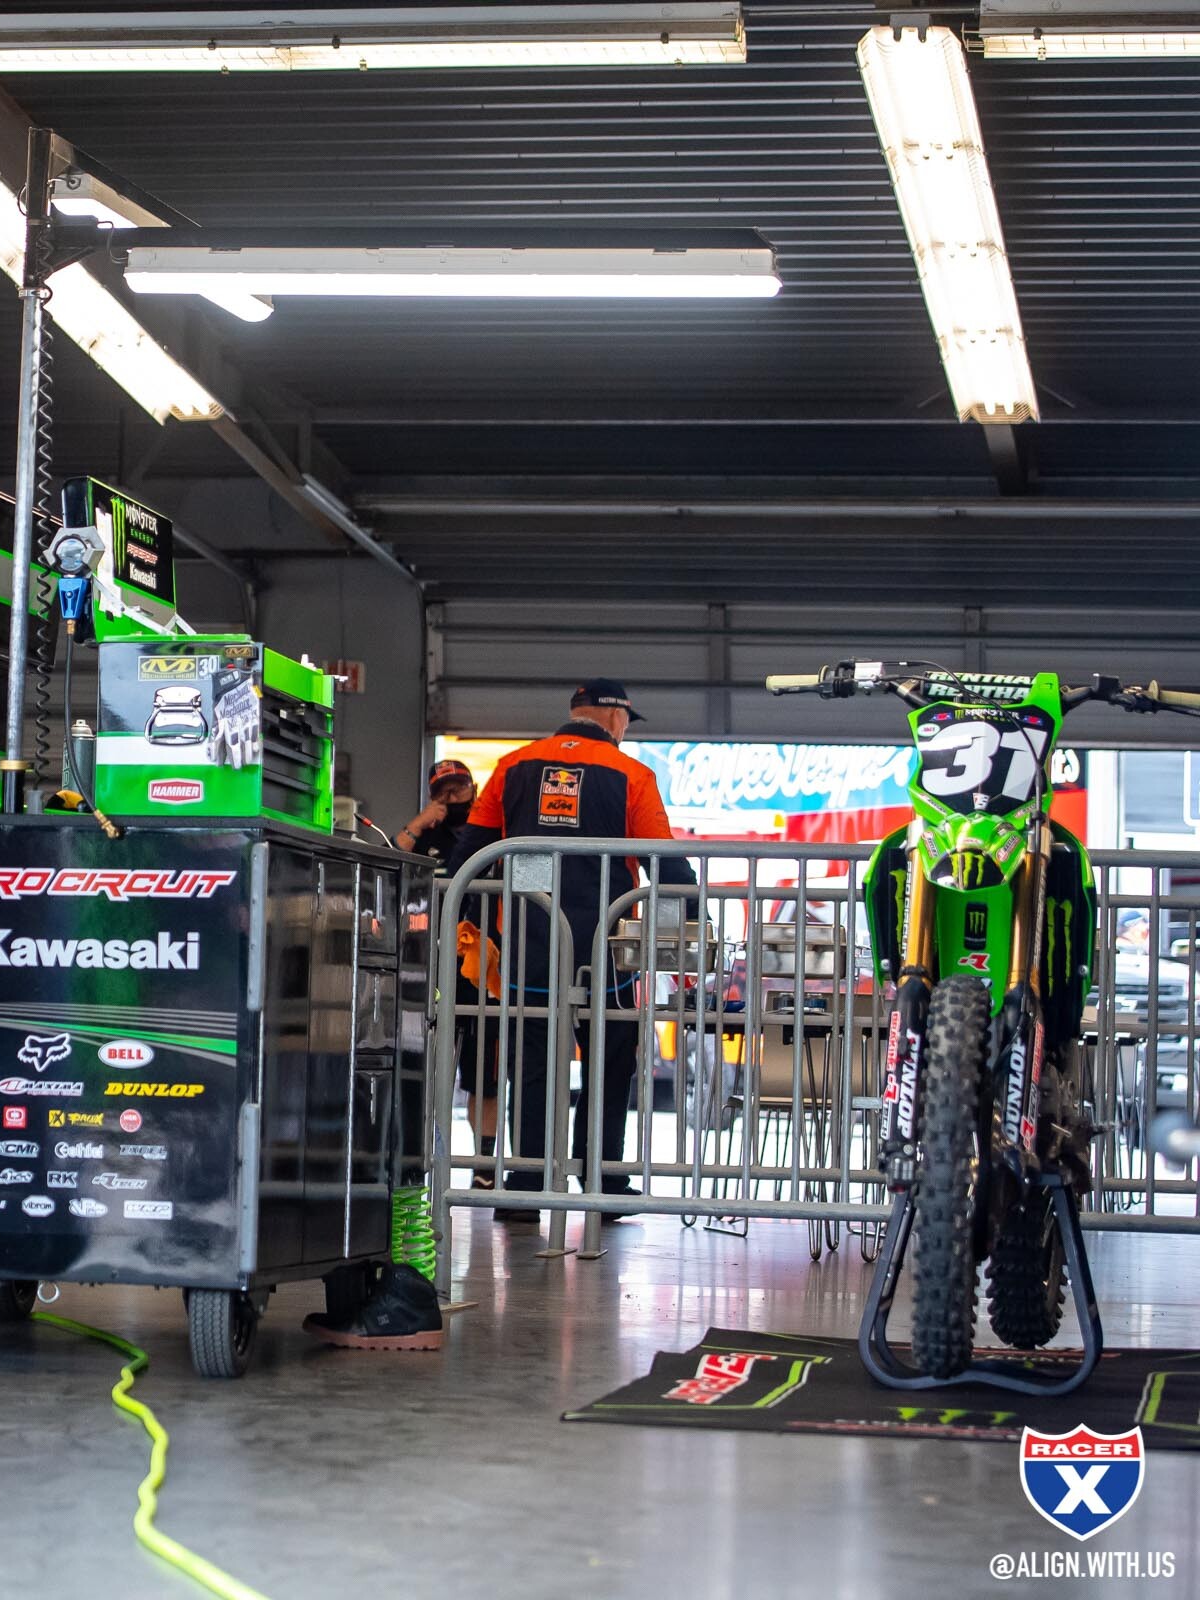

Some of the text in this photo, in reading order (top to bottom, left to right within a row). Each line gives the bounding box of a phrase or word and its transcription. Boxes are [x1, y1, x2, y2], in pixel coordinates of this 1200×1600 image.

[125, 503, 158, 535] MONSTER
[129, 562, 157, 589] Kawasaki
[199, 656, 218, 676] 30
[928, 672, 1032, 684] RENTHA
[917, 721, 1049, 801] 31
[152, 784, 200, 798] HAMMER
[47, 867, 237, 901] CIRCUIT
[107, 1048, 144, 1060] BELL
[104, 1082, 205, 1098] DUNLOP
[49, 1173, 77, 1187] RK
